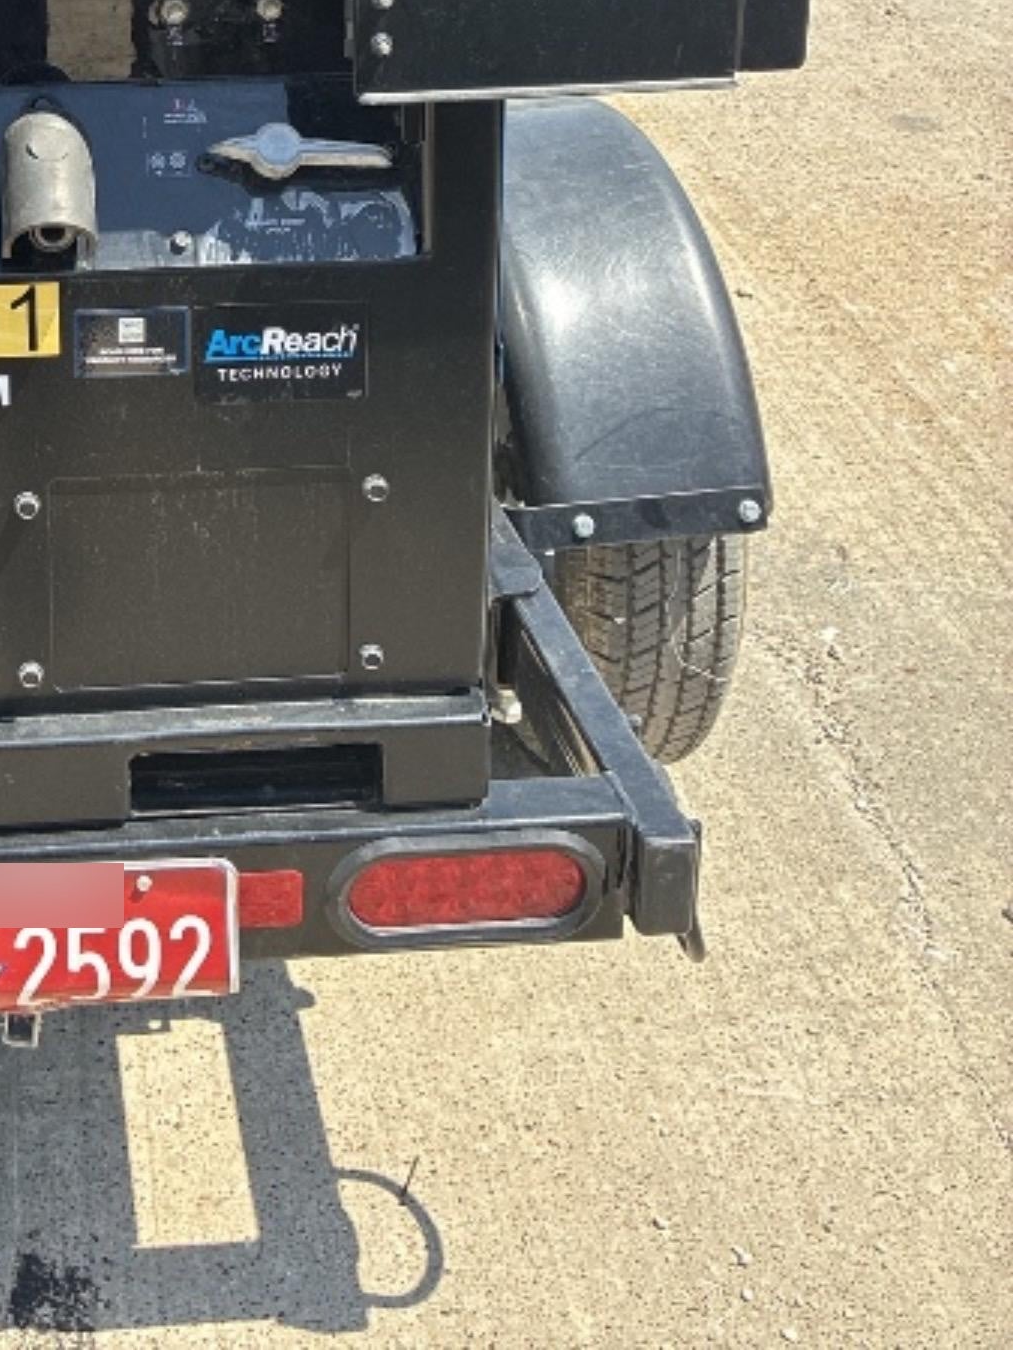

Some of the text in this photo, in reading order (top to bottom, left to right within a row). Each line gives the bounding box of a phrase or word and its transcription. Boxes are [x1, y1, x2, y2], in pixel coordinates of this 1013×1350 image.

[205, 324, 358, 356] ArcReach
[217, 363, 343, 382] TECHNOLOGY
[13, 914, 211, 1008] 2592
